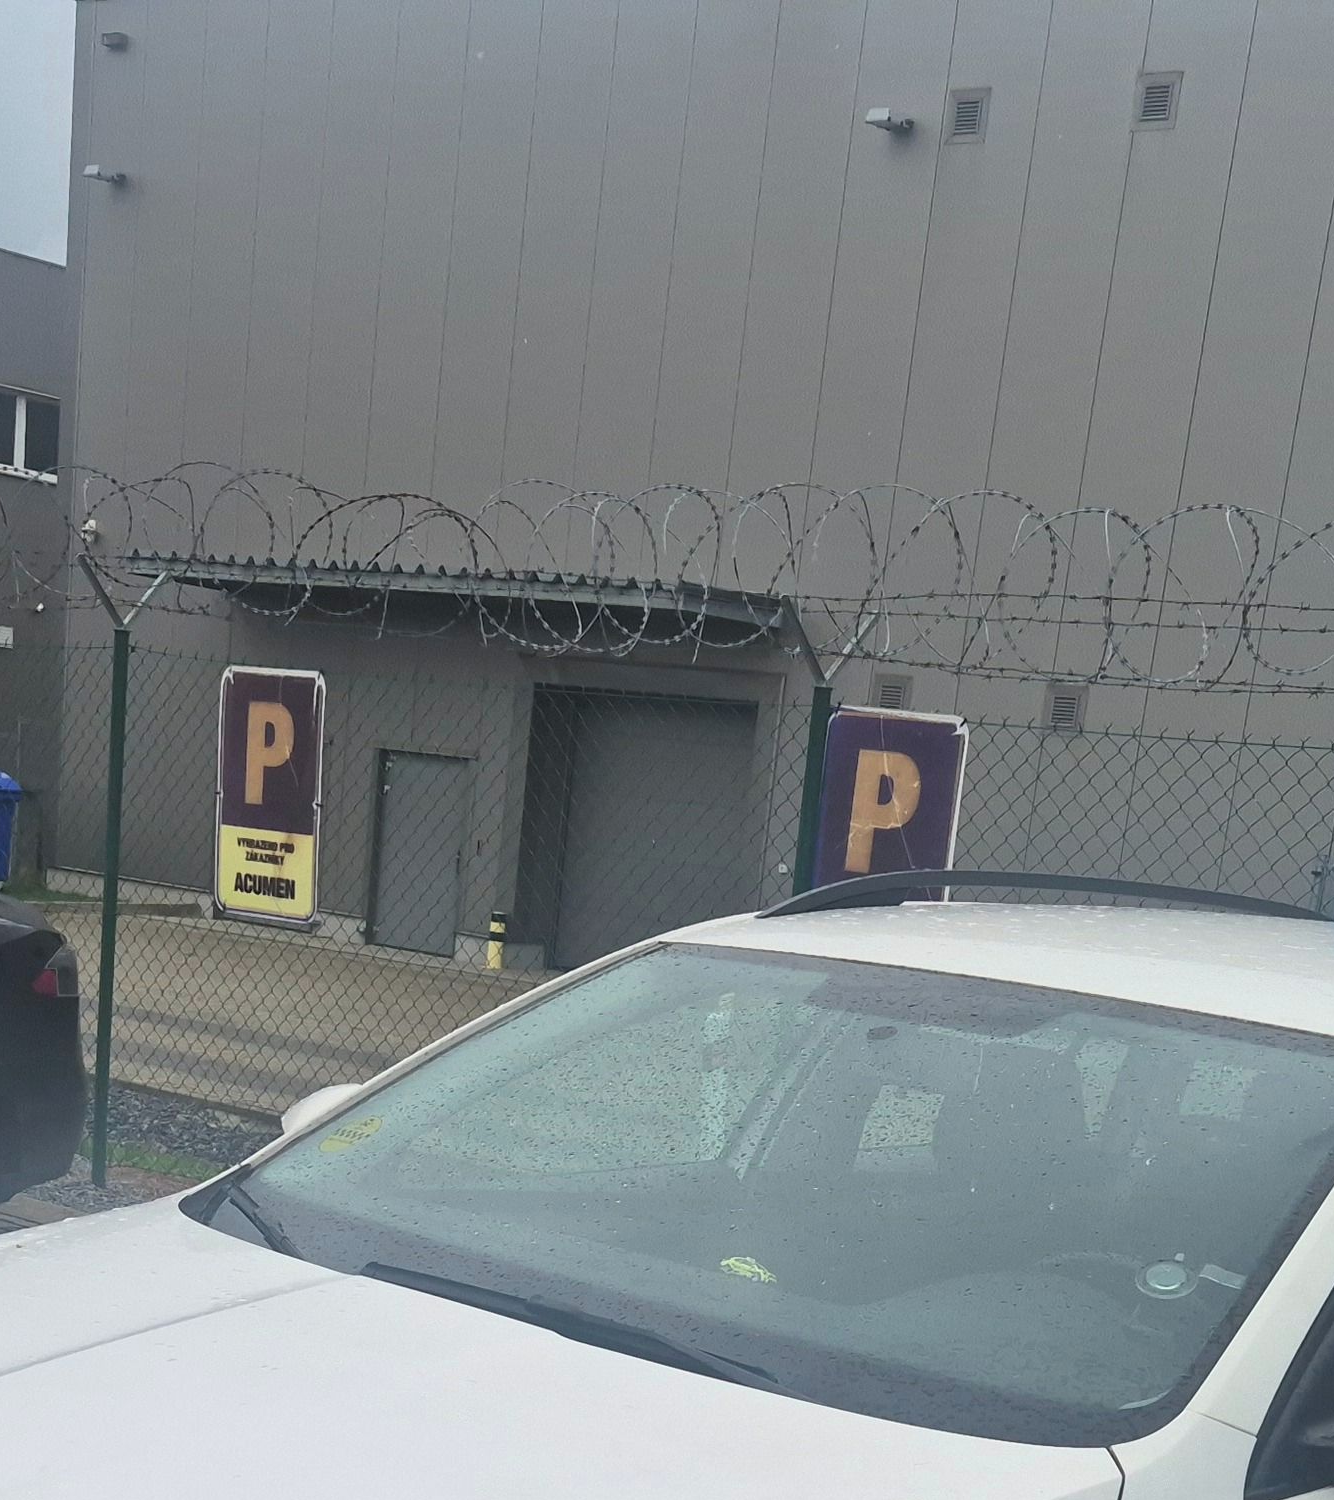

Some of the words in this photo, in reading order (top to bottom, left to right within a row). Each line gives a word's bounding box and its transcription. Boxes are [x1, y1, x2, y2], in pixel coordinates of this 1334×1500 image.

[244, 701, 295, 805] P
[844, 749, 922, 874] P
[233, 872, 296, 900] ACUMEN
